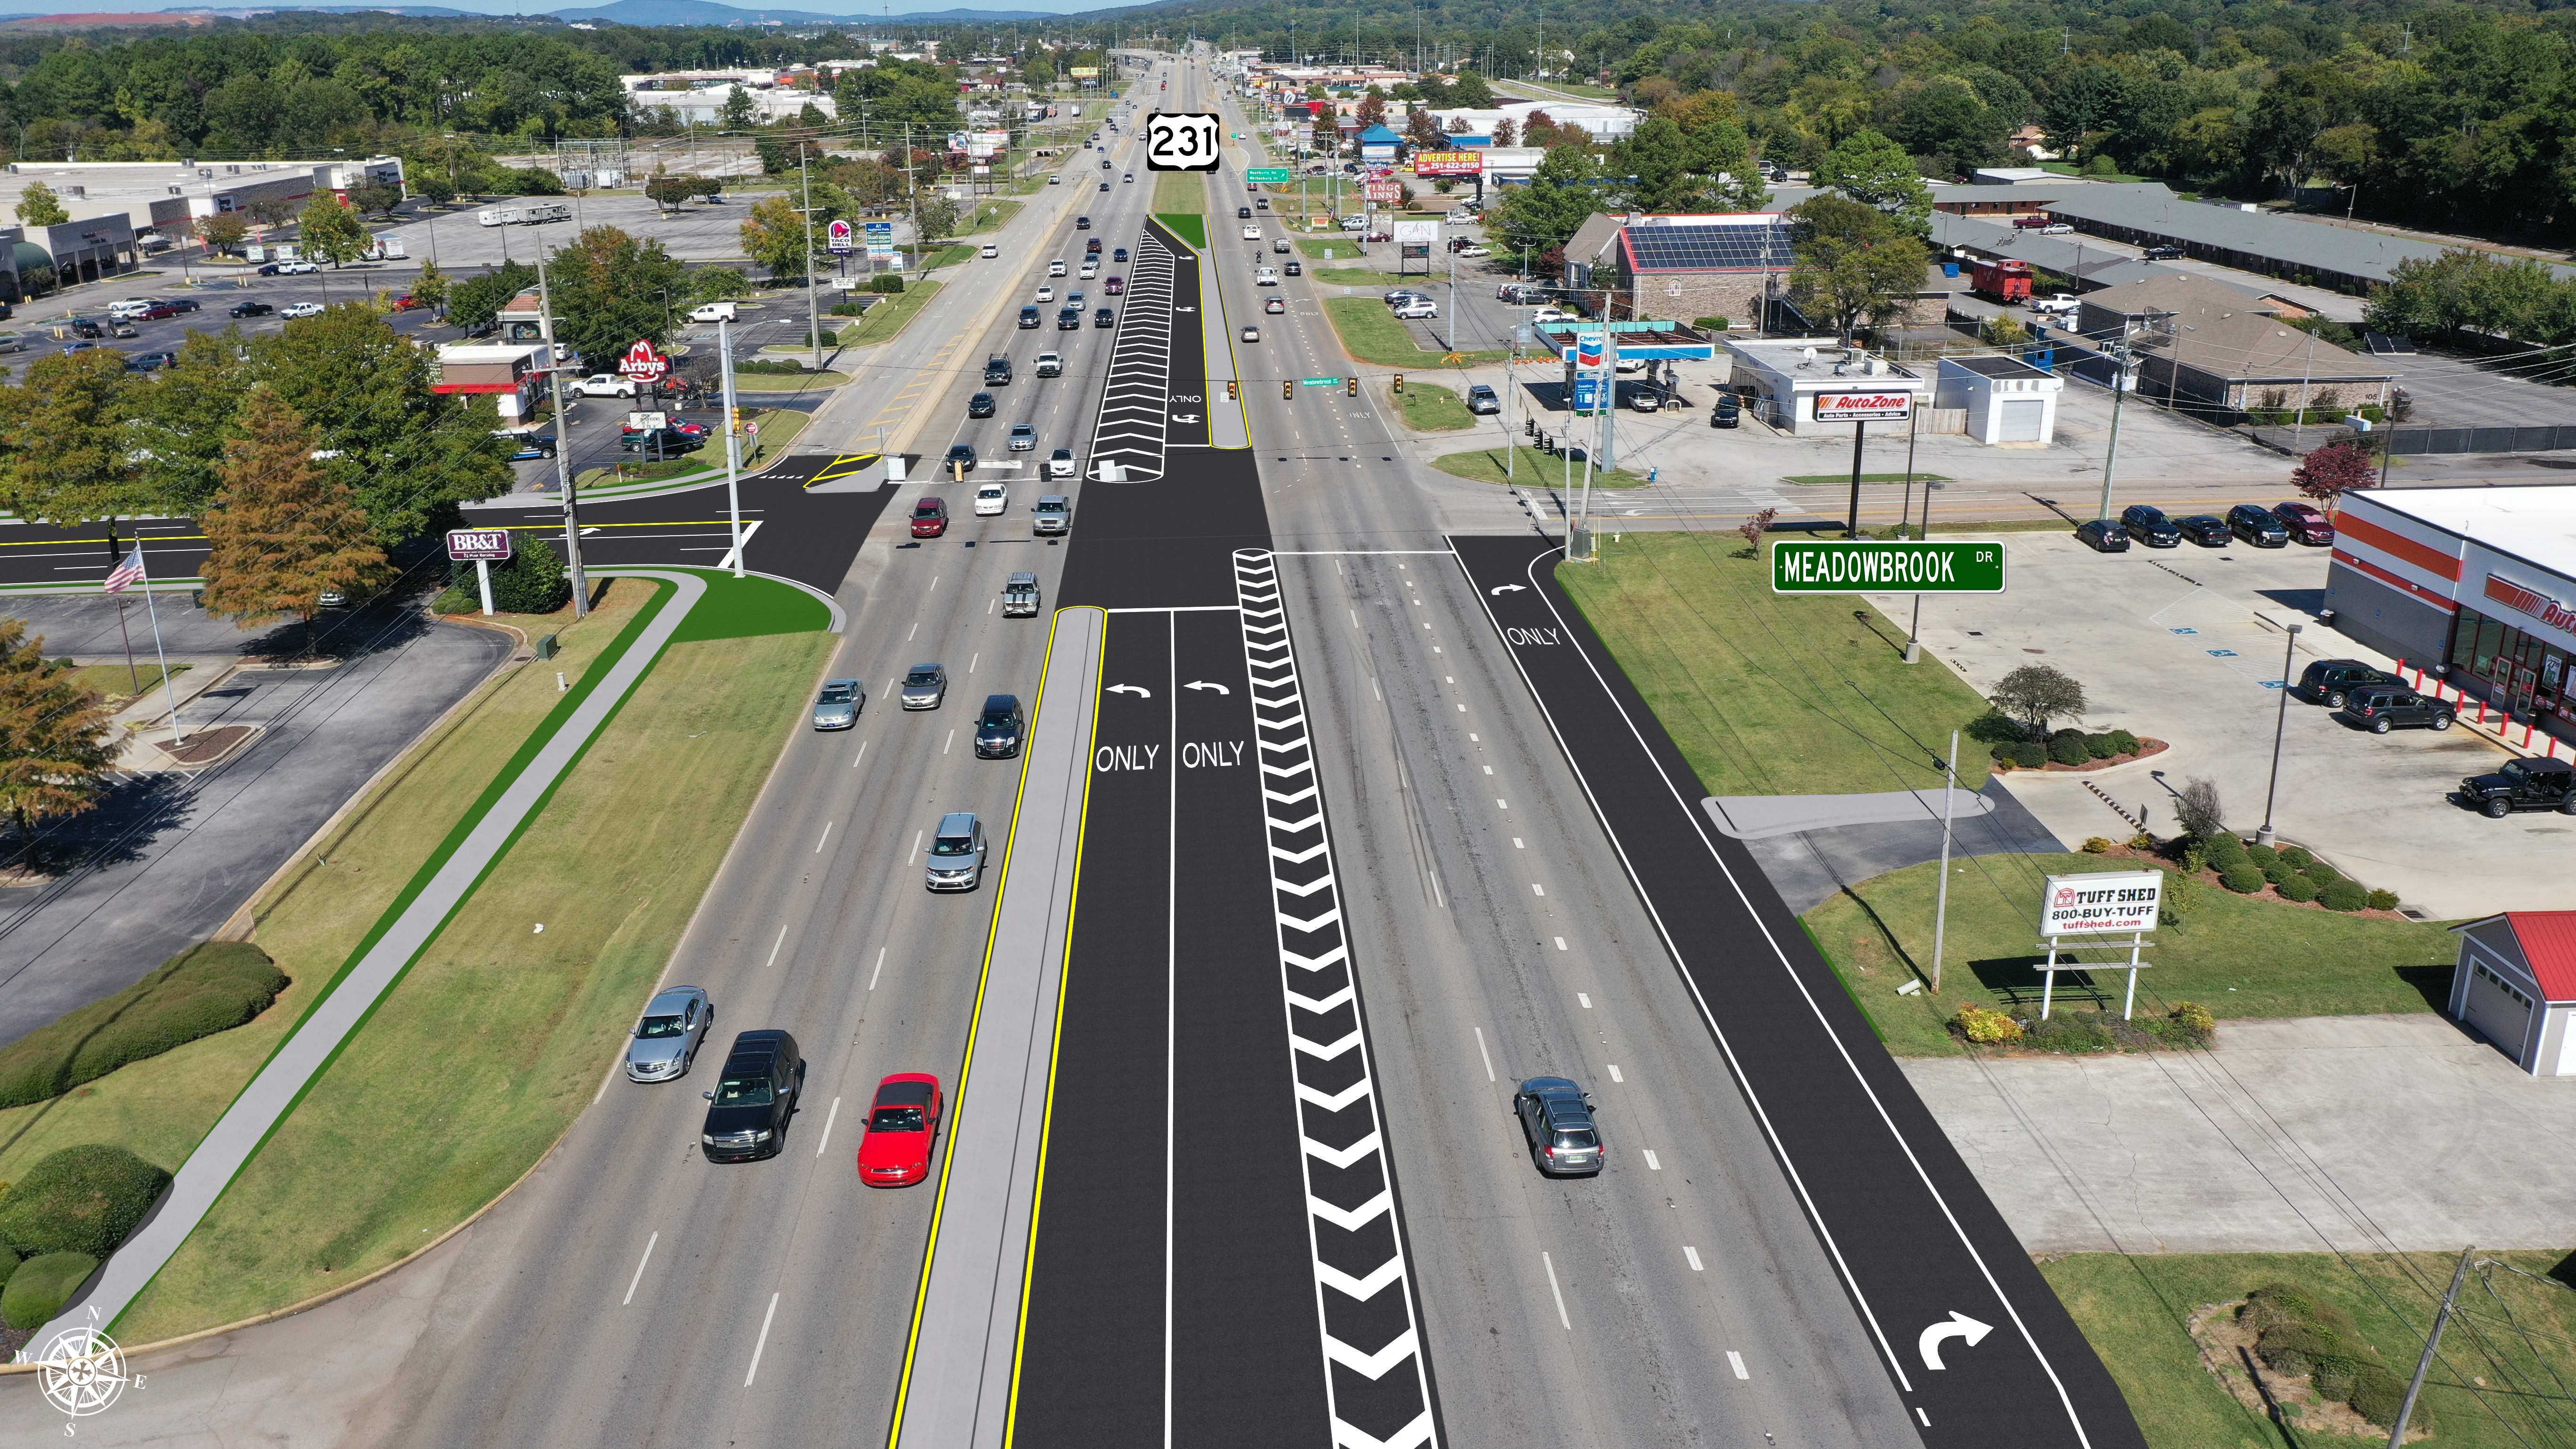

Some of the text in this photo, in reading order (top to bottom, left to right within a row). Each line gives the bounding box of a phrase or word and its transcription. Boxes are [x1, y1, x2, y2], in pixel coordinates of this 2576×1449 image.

[1418, 153, 1480, 162] ADVERTISE HERE!
[619, 358, 665, 375] Arby's
[1579, 394, 1583, 403] 1
[1835, 395, 1905, 409] AutoZone
[452, 534, 501, 550] BB&T
[2541, 603, 2576, 636] Aut
[2077, 888, 2156, 904] TUFF SHED
[2052, 906, 2154, 920] 800-BUY-TUFF
[2063, 919, 2141, 929] tuffshed.com
